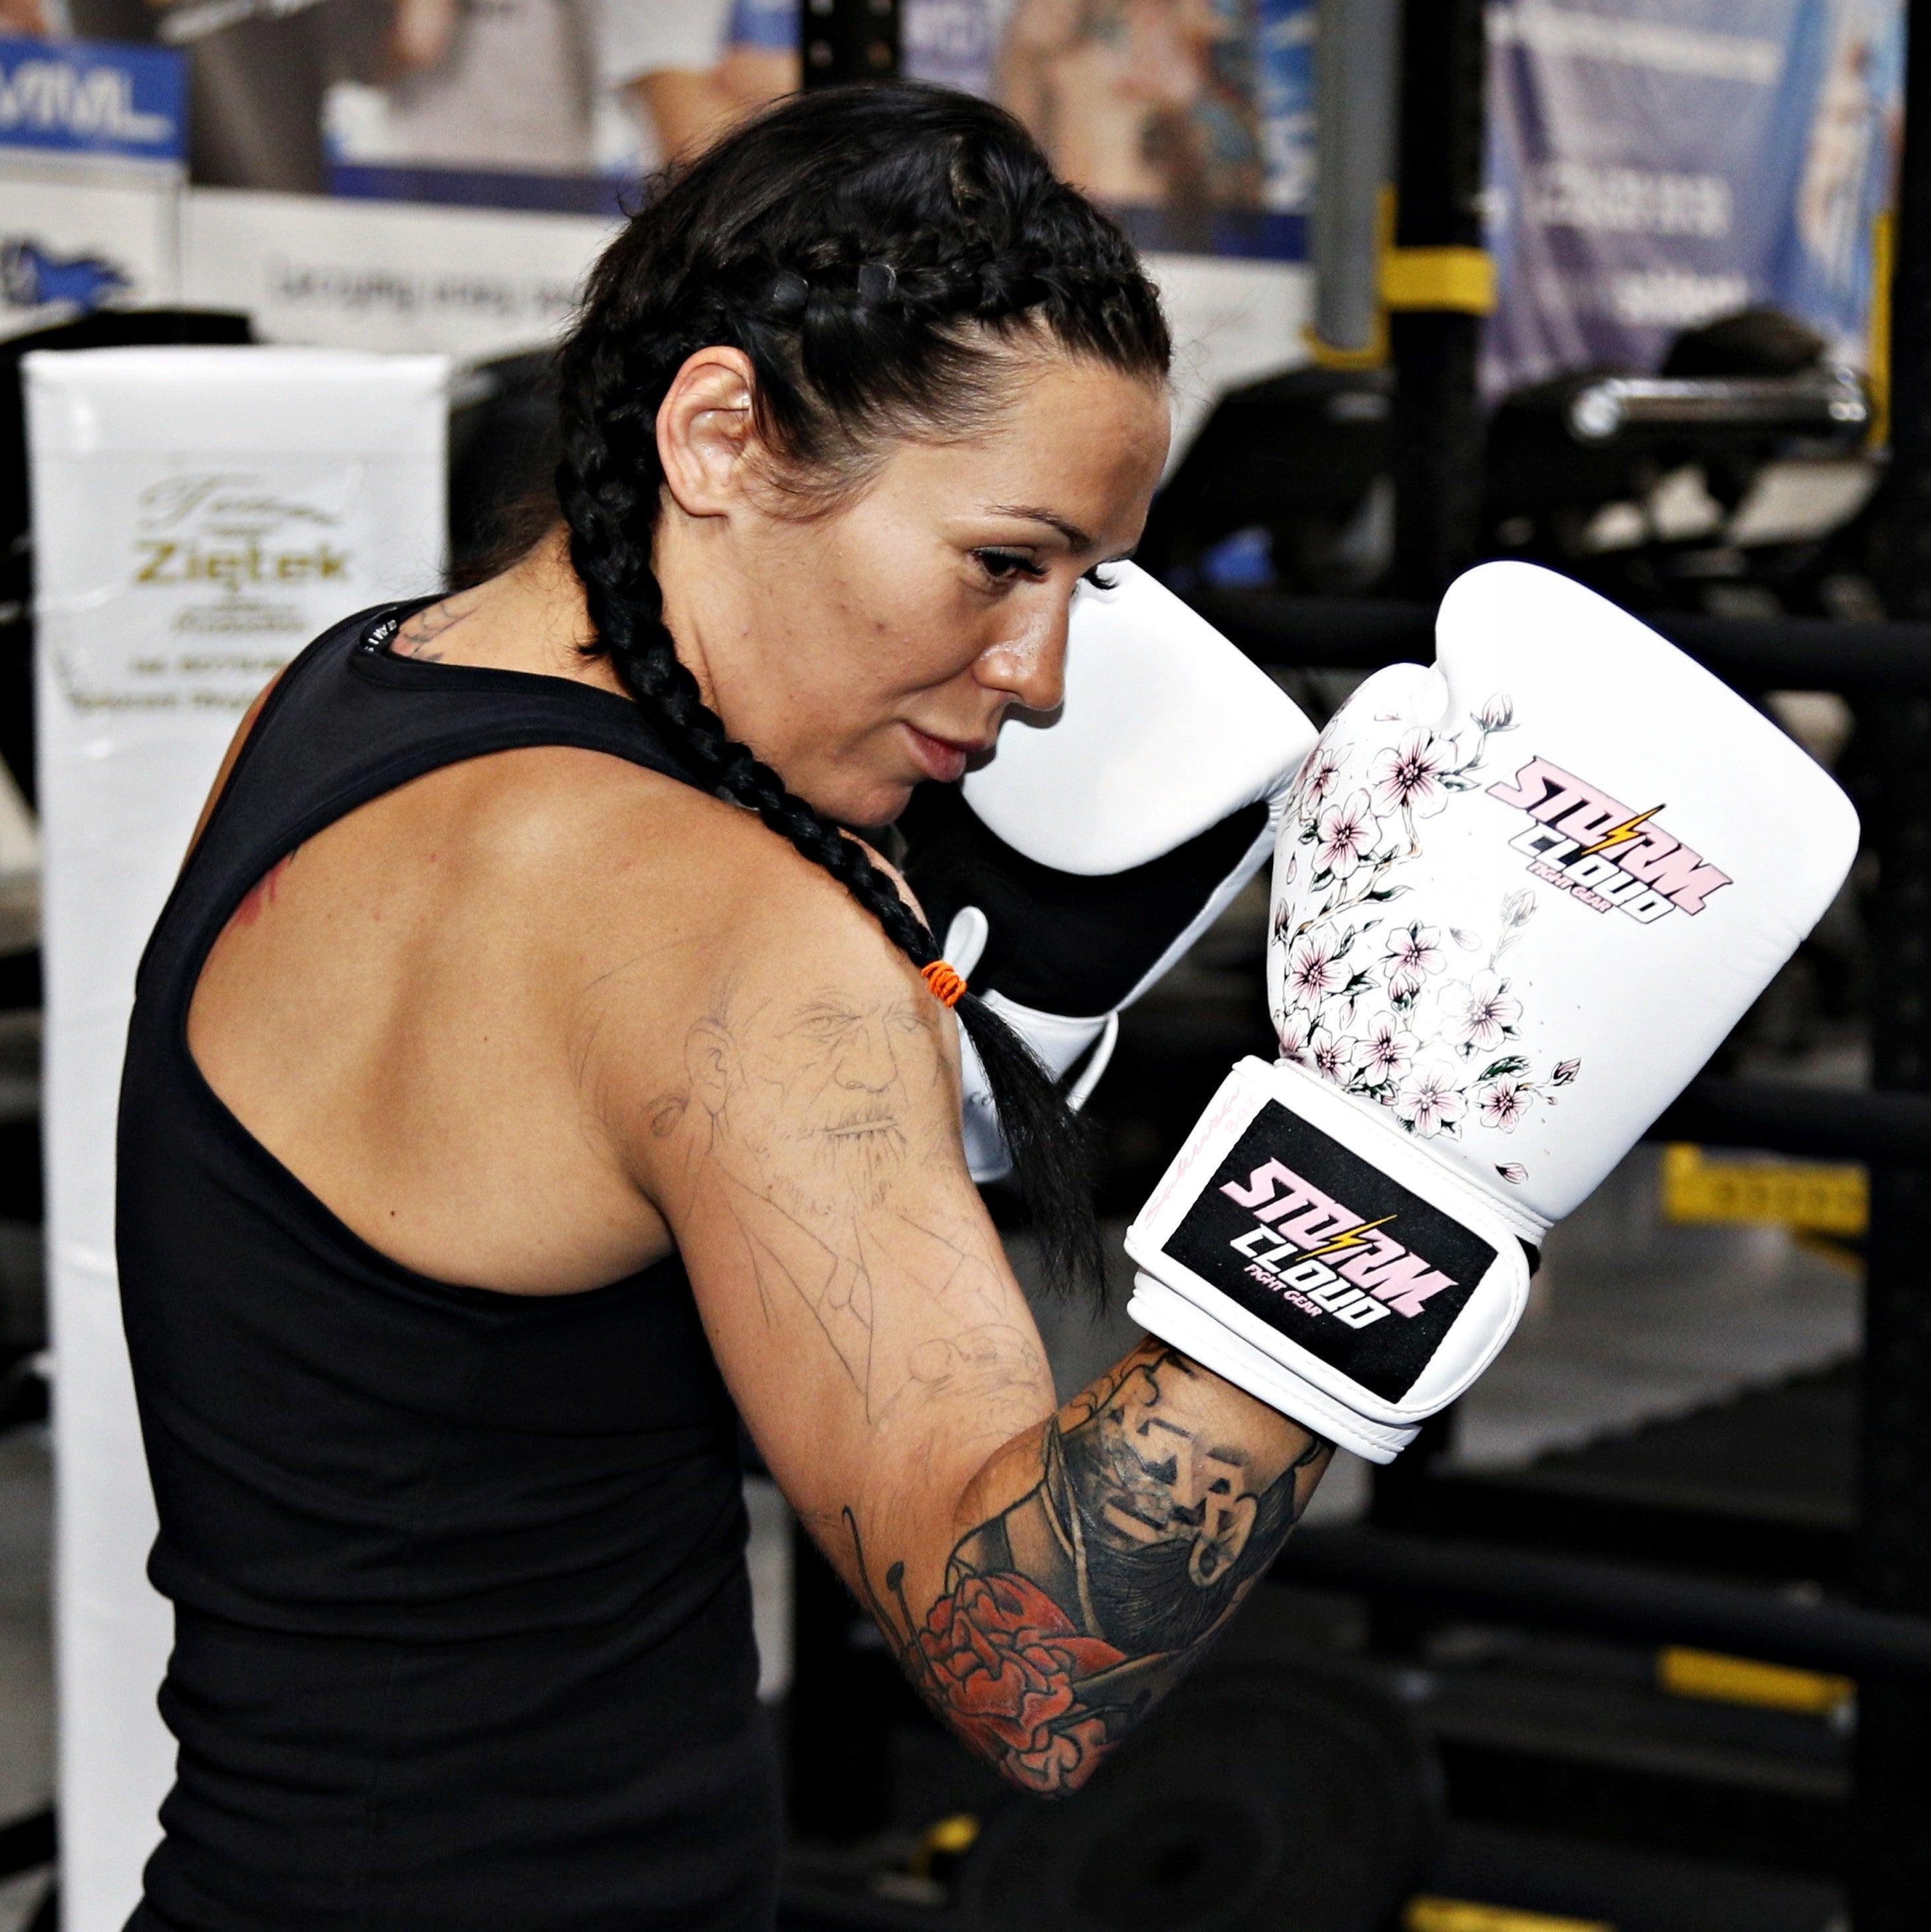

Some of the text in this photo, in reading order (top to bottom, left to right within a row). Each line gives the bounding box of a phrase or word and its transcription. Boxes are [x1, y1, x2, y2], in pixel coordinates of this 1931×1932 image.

[1486, 755, 1733, 916] STORM
[1508, 821, 1676, 924] CLOUD
[1527, 862, 1613, 913] FIGHT GEAR
[1219, 1157, 1459, 1318] STORM
[1230, 1223, 1392, 1329] CLOUD
[1244, 1264, 1322, 1317] FIGHT GEAR
